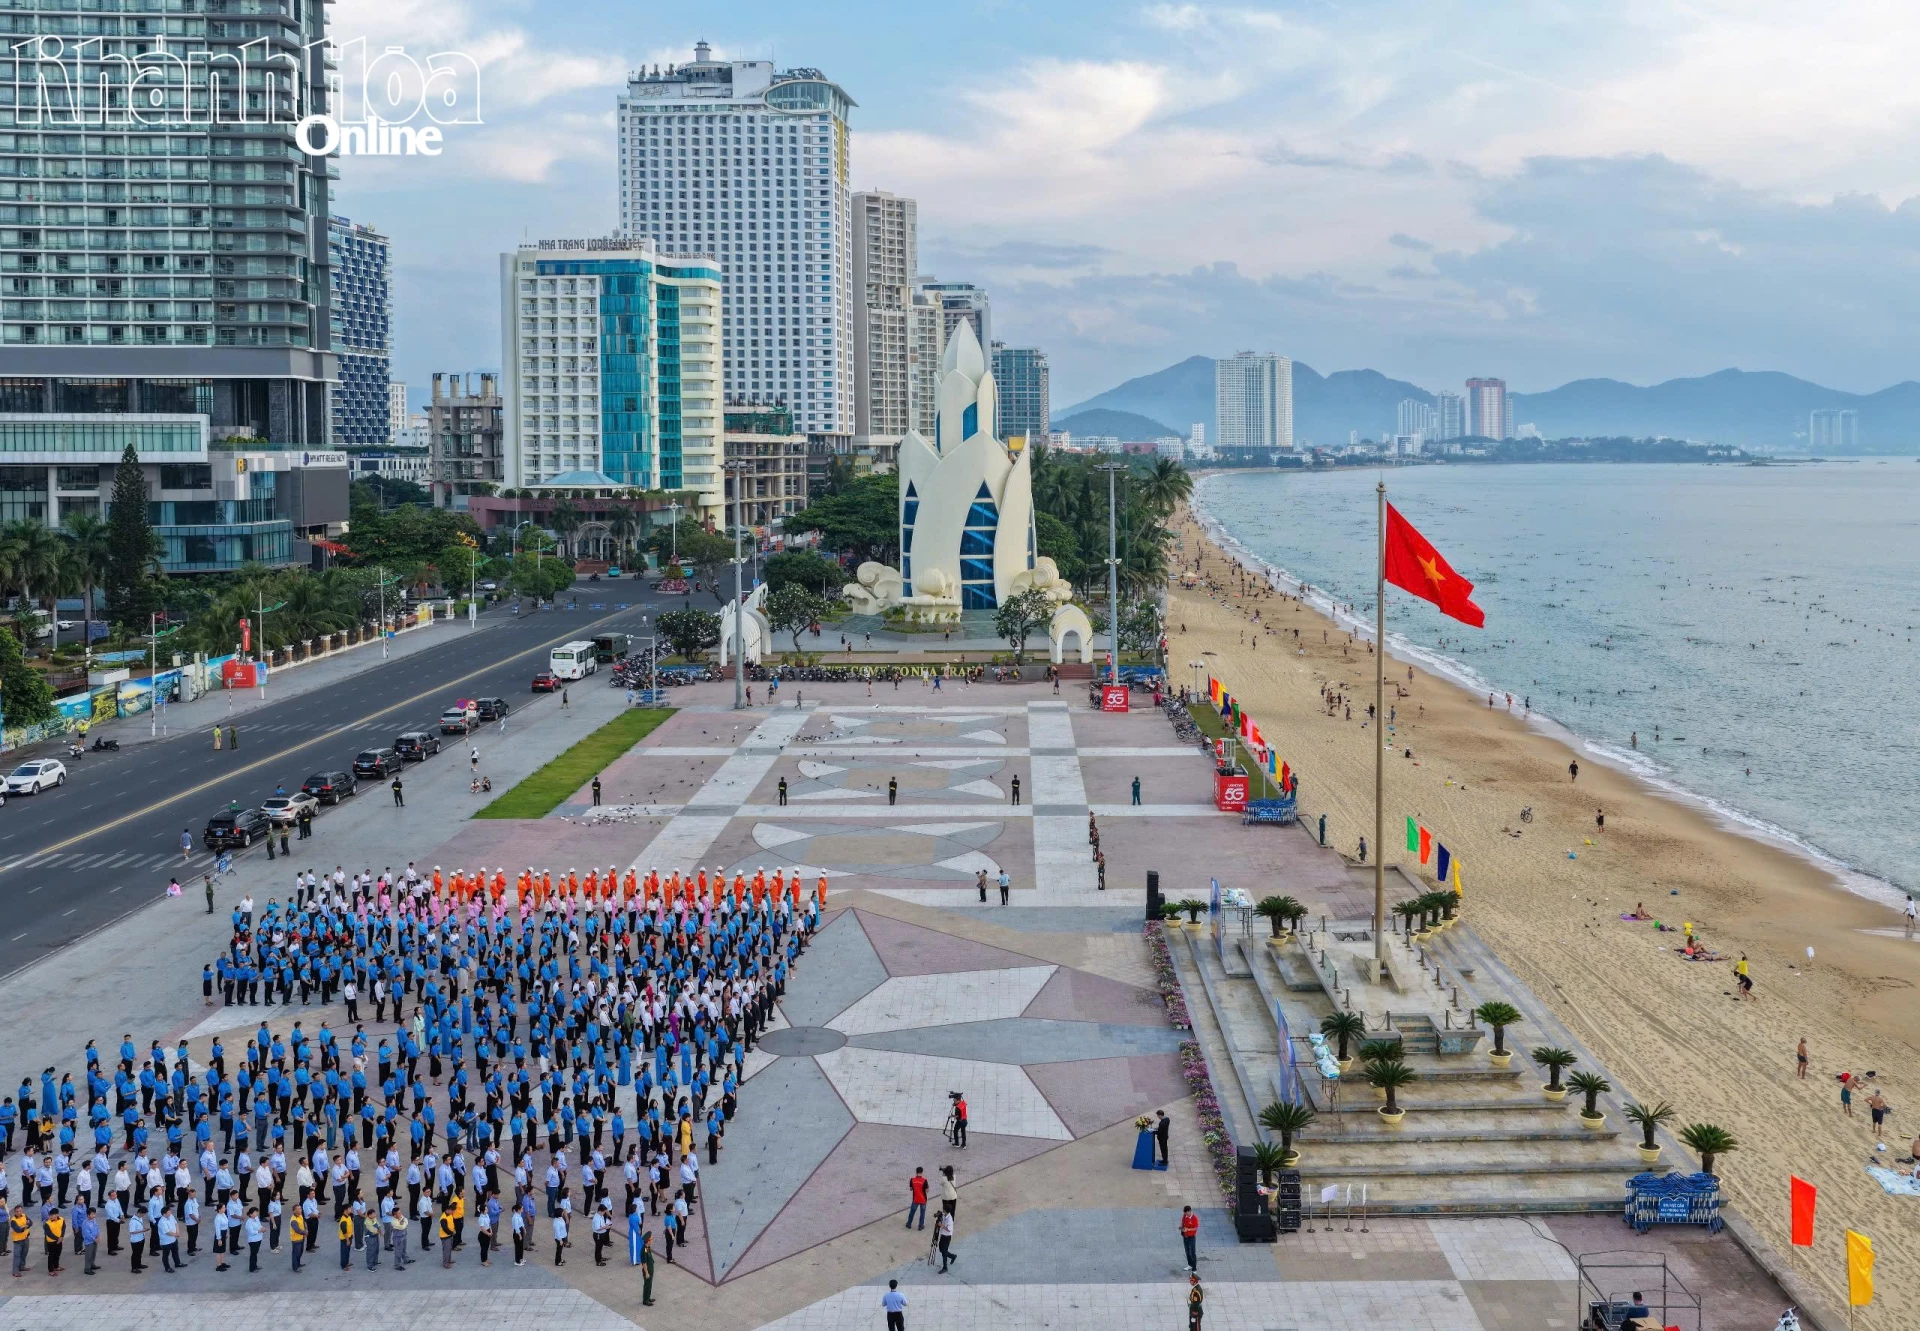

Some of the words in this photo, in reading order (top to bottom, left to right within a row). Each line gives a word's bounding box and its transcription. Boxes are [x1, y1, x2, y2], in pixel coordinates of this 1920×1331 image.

[538, 239, 556, 251] NHA
[557, 239, 585, 251] TRANG
[1107, 693, 1124, 704] 5G
[1224, 787, 1244, 800] 5G
